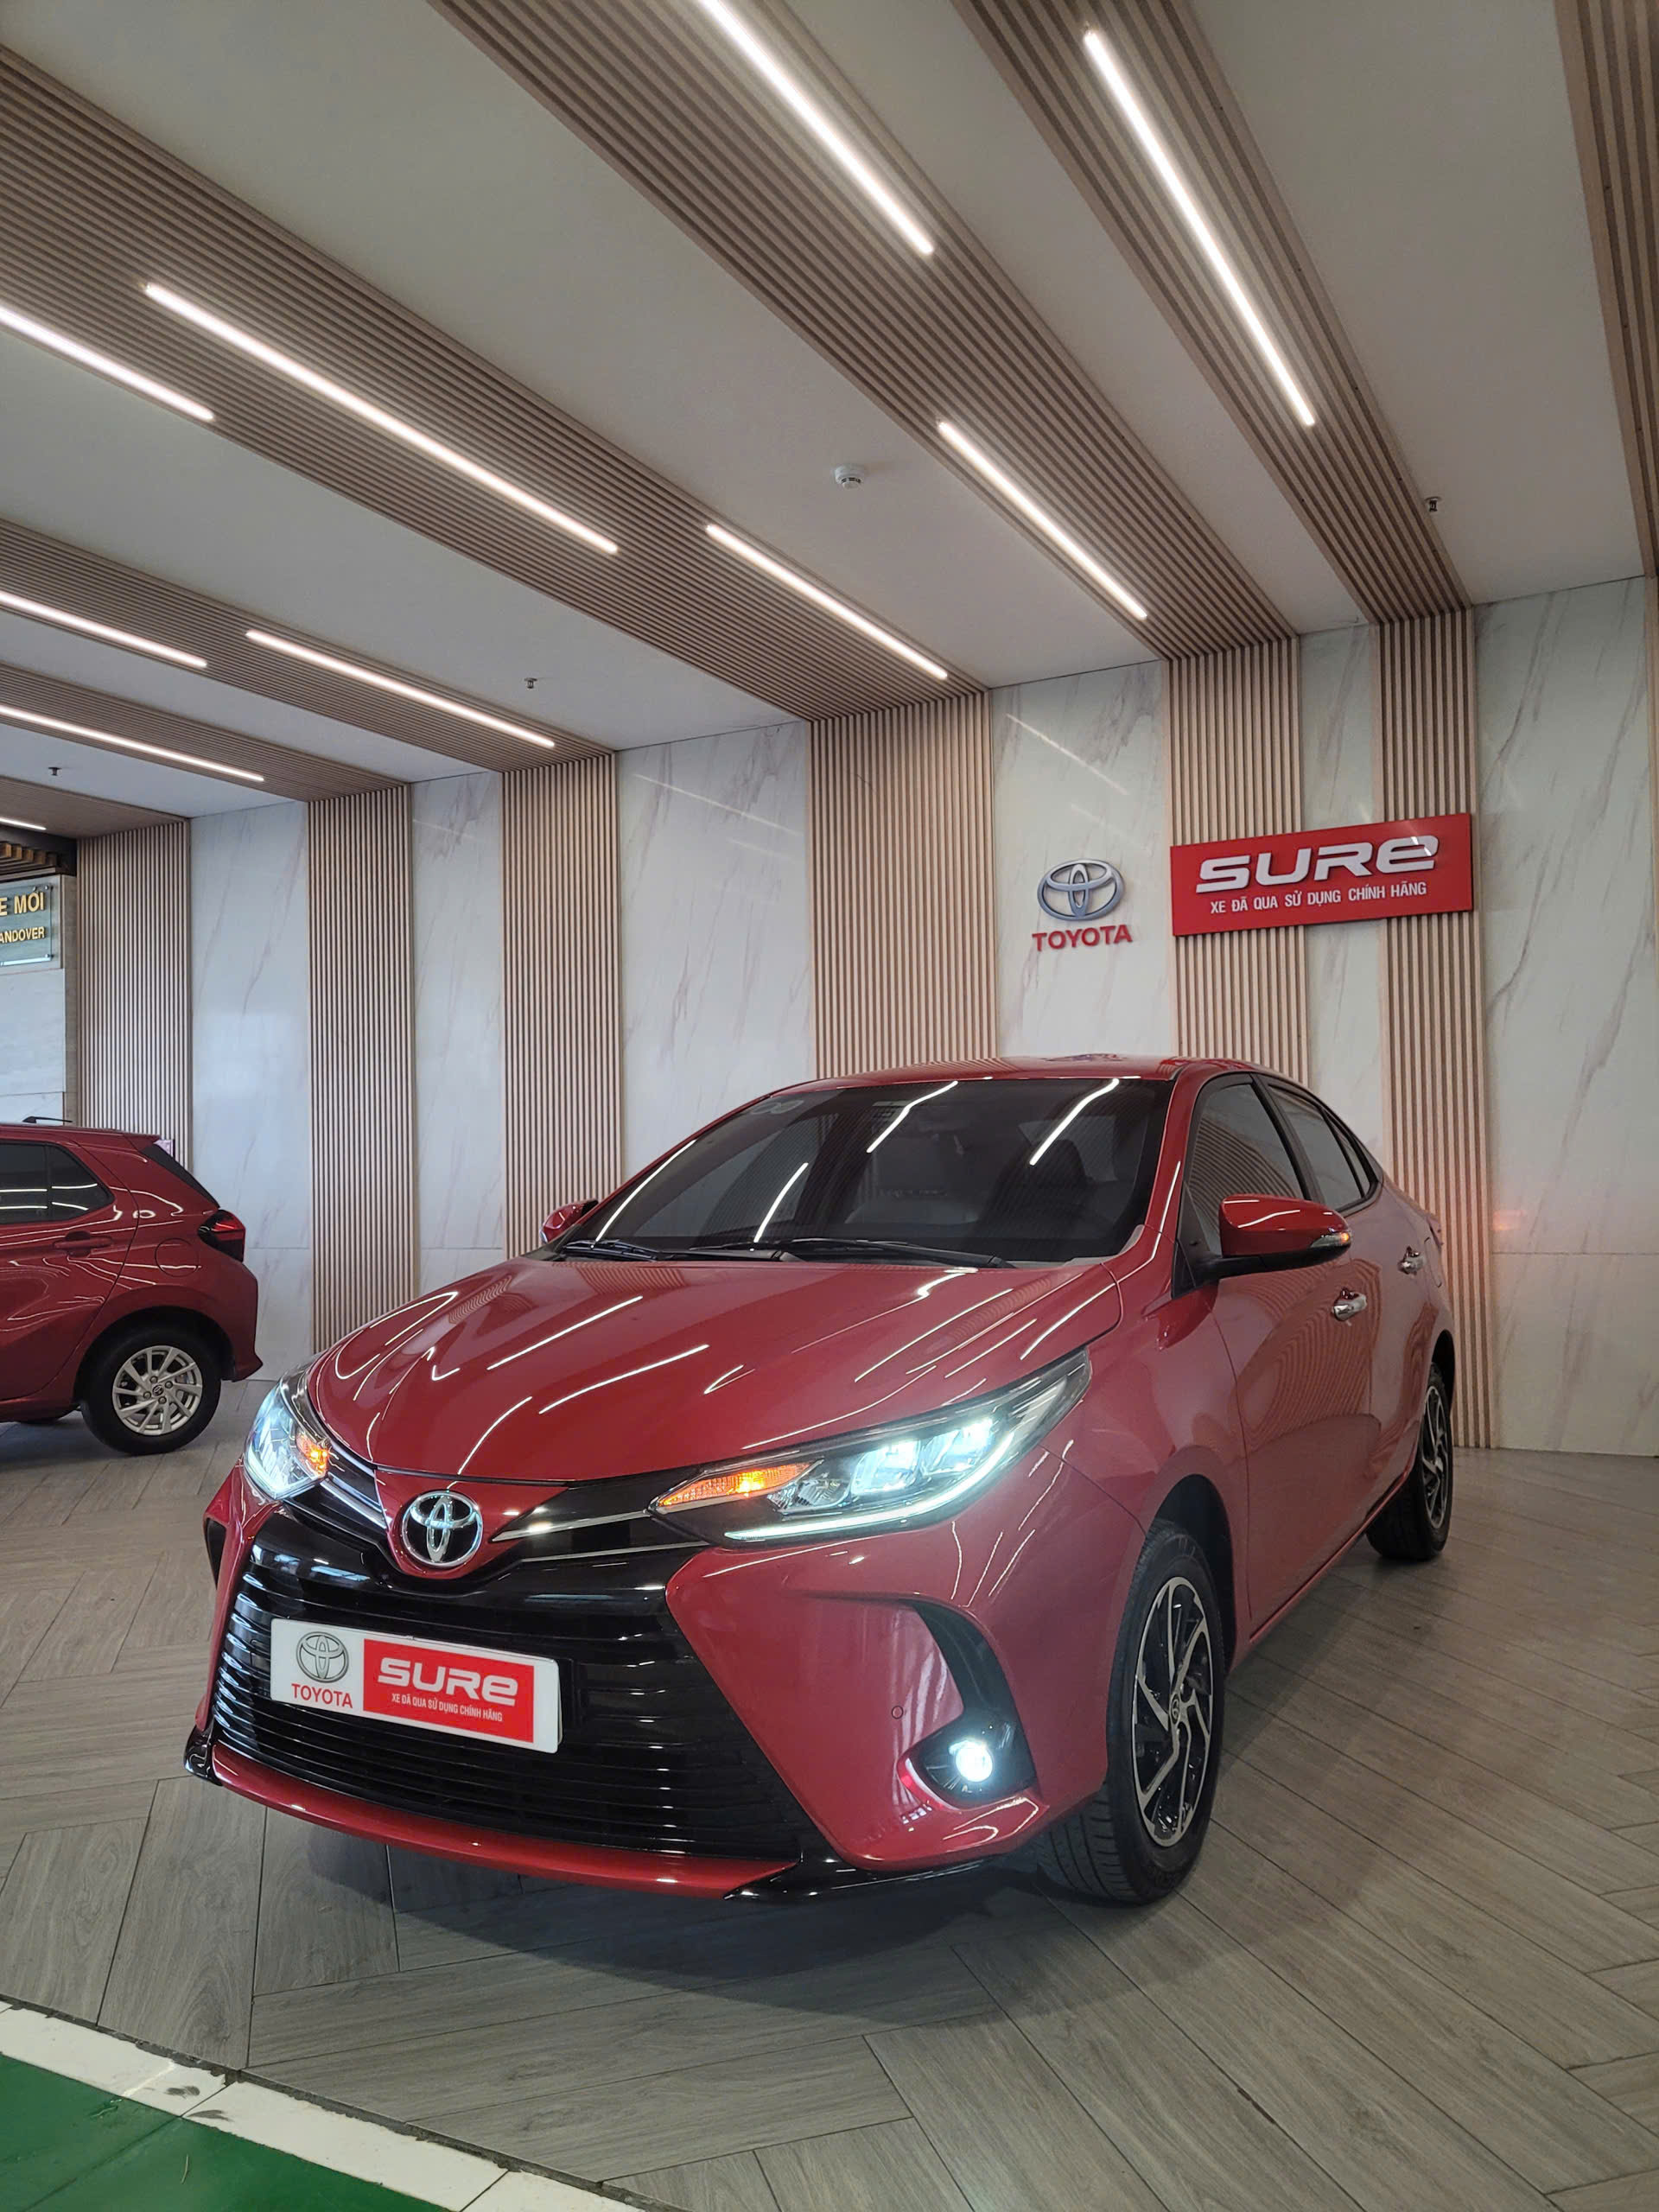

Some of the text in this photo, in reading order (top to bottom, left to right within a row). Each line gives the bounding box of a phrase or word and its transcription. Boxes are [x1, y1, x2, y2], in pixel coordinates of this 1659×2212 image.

[1211, 880, 1427, 914] XE ĐÃ QUA SỬ DỤNG CHÍNH HÃNG
[1032, 924, 1133, 951] TOYOTA
[291, 1683, 353, 1708] TOYOTA
[391, 1693, 503, 1722] XE ĐÃ QUA SỬ DỤNG CHÍNH HÃNG
